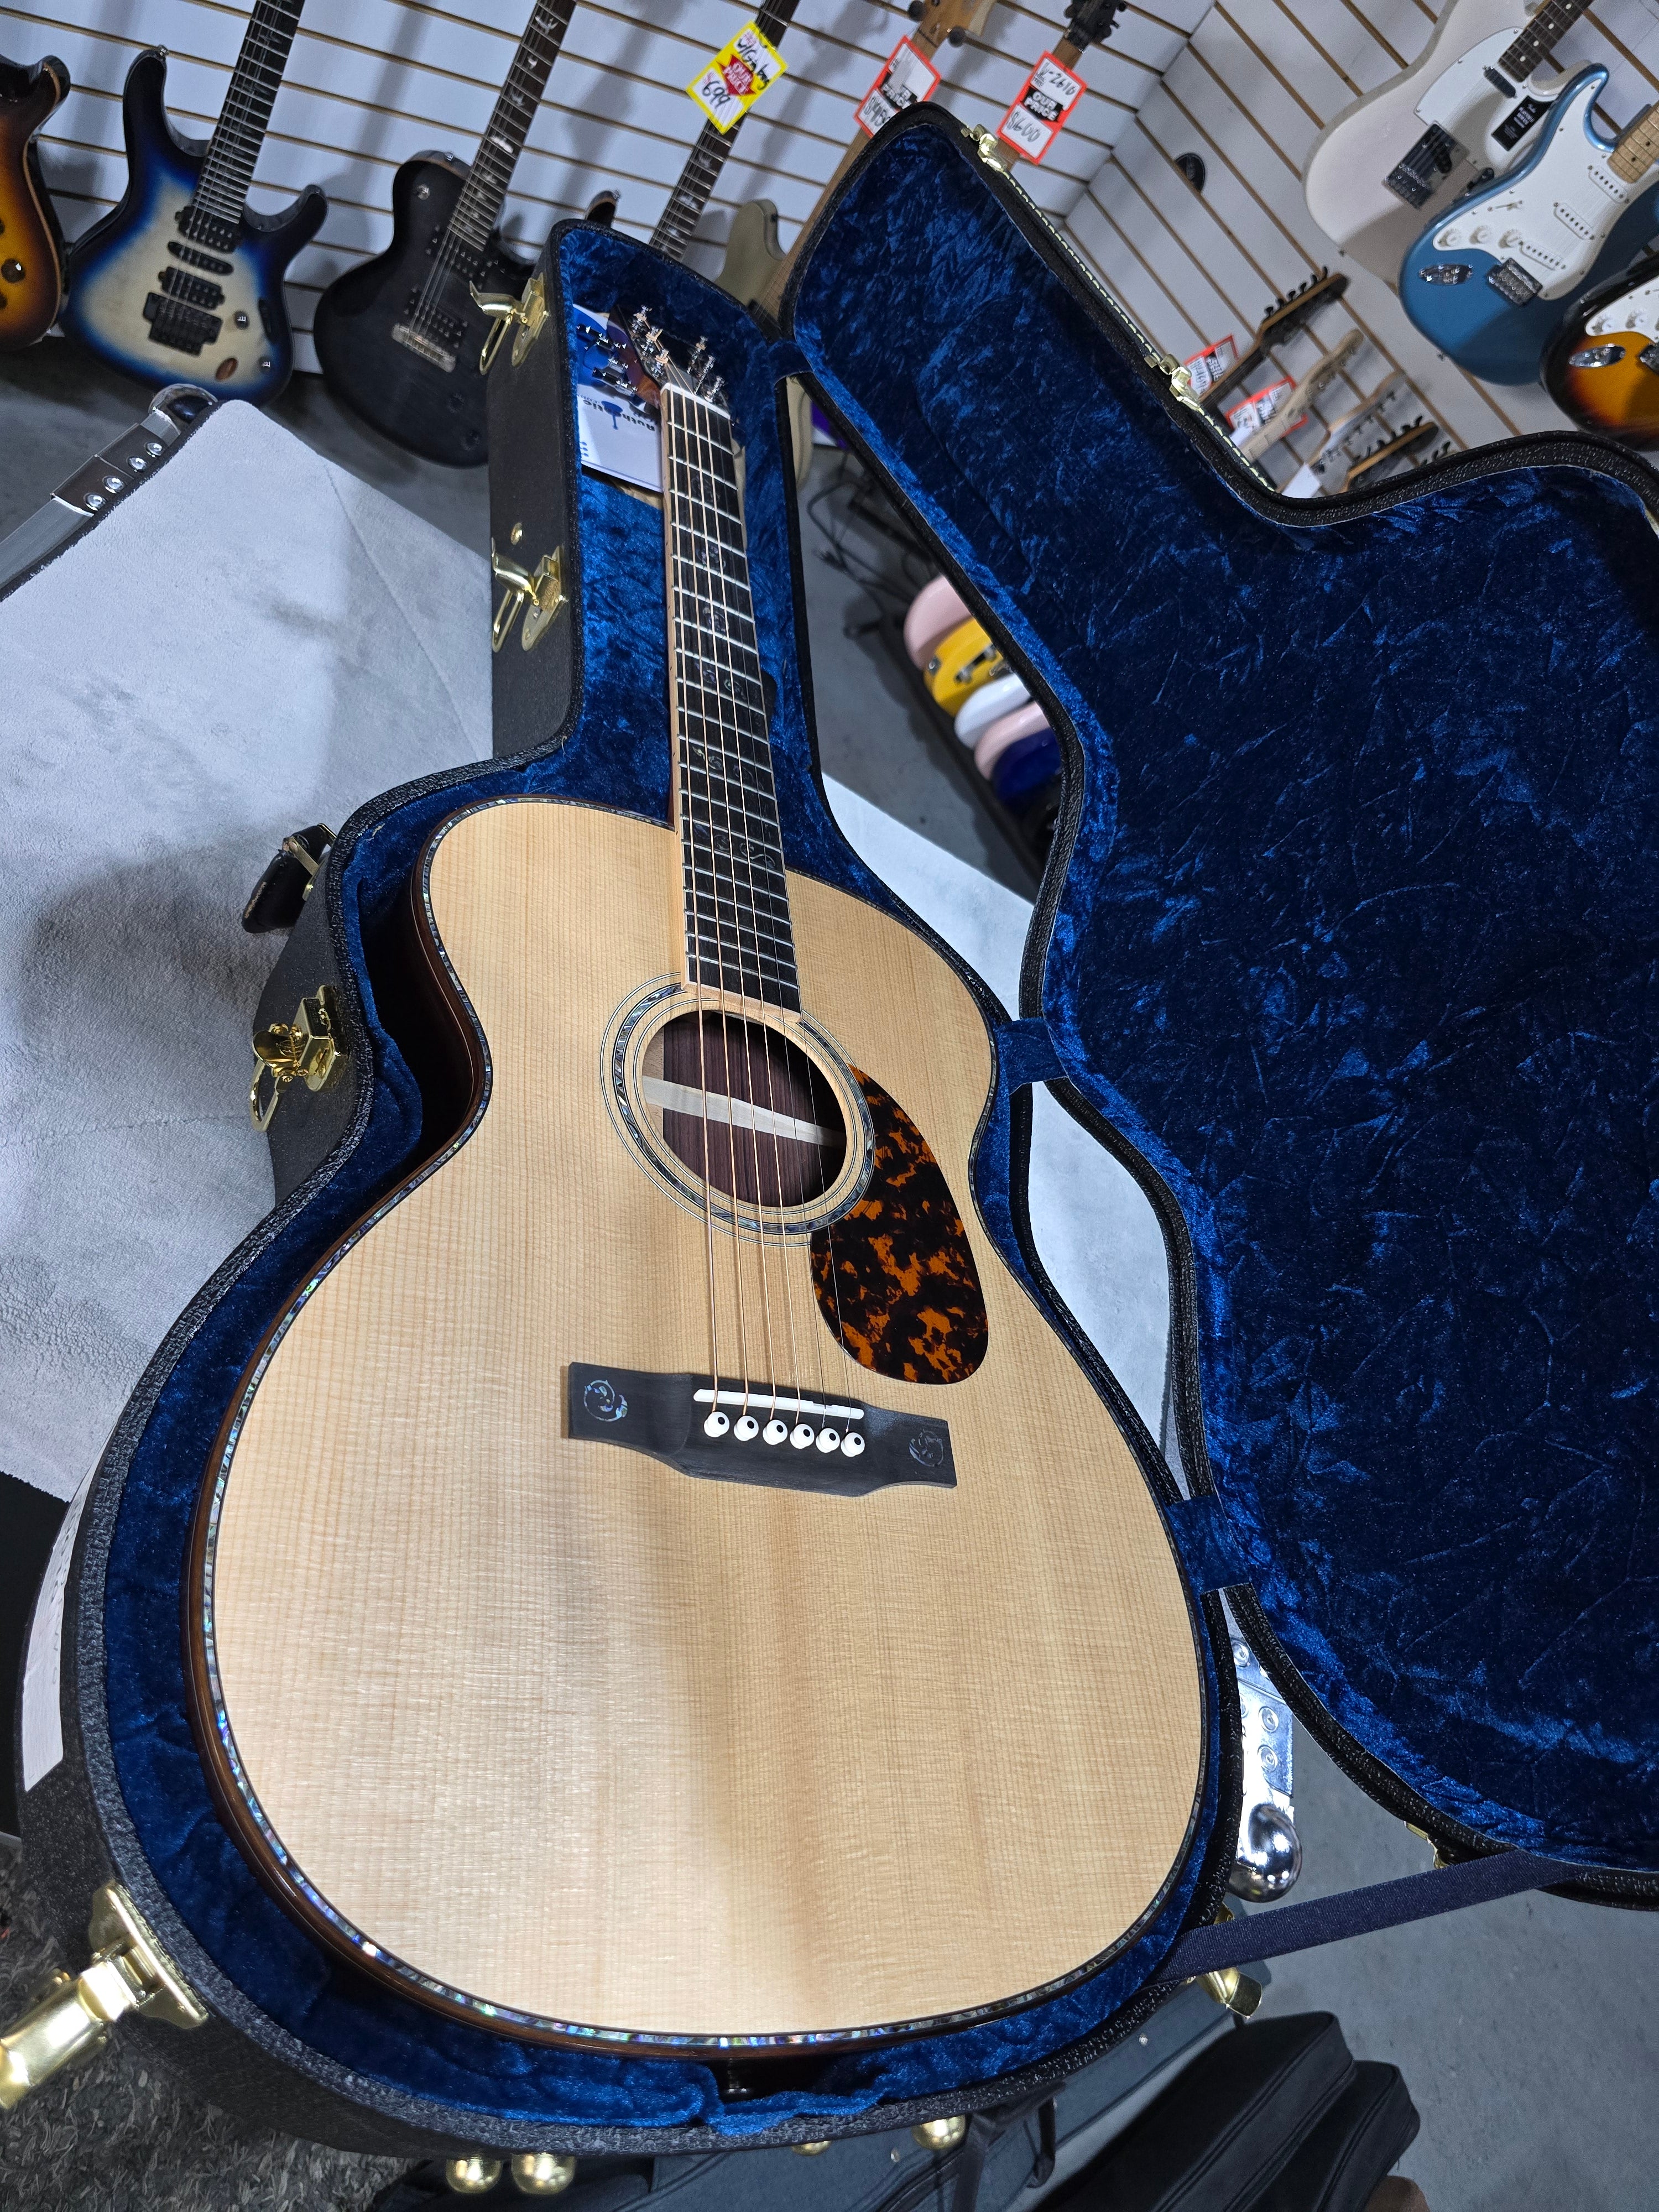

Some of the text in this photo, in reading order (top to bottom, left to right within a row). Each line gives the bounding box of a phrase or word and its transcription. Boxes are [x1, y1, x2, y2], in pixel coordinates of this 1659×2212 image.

[723, 65, 750, 95] PRICE
[732, 62, 753, 85] OUR
[1024, 98, 1058, 121] PRICE
[1033, 91, 1057, 111] OUR
